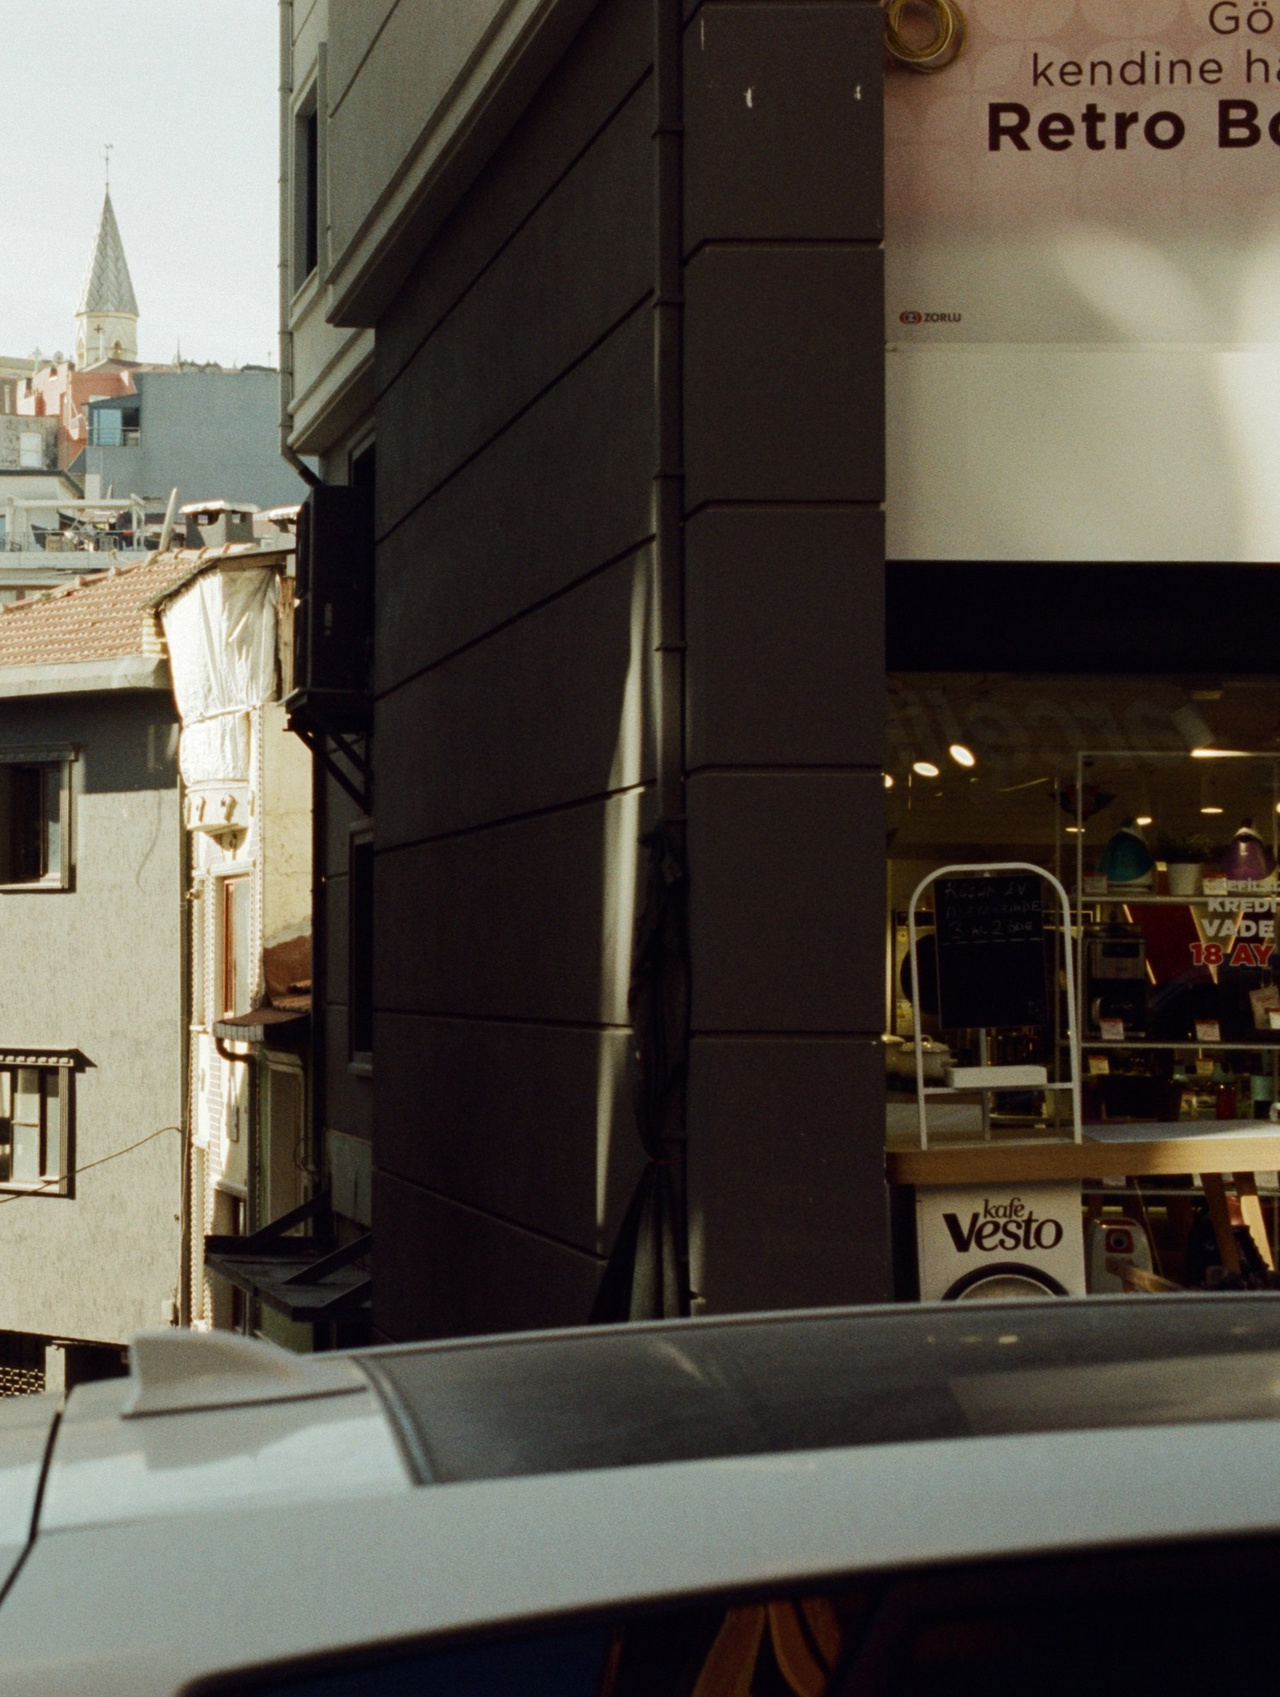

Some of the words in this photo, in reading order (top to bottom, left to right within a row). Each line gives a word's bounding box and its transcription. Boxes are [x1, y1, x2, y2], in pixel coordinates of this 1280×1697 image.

[1208, 1, 1274, 35] Gö
[1033, 49, 1224, 87] kendine
[1246, 48, 1280, 84] h
[988, 102, 1186, 152] Retro
[923, 312, 962, 323] ZORLU
[1207, 893, 1277, 913] KREDİ
[991, 919, 1006, 936] 2
[1200, 918, 1275, 938] VADE
[1188, 941, 1224, 966] 18
[1229, 942, 1276, 967] AY
[983, 1196, 1025, 1219] kafe
[942, 1210, 1064, 1253] Vesto
